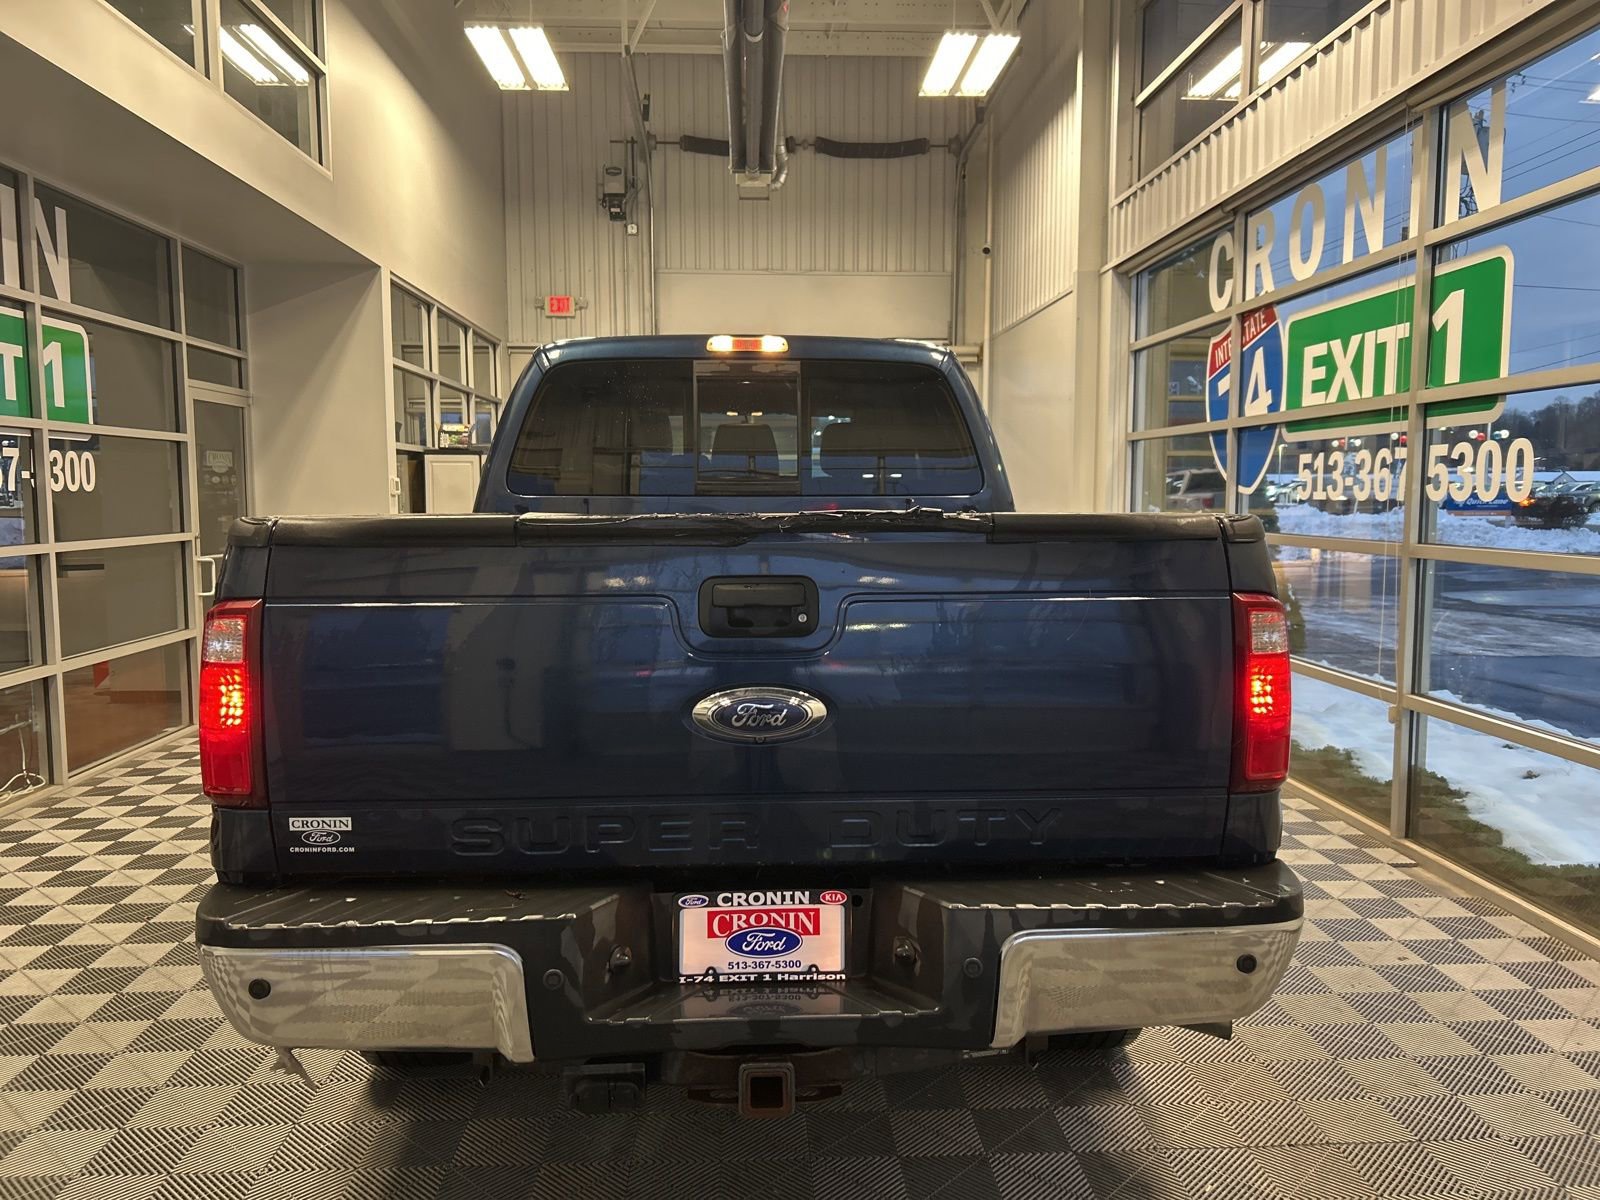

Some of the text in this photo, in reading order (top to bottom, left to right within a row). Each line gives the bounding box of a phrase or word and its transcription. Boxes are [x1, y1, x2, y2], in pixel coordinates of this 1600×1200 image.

[1208, 83, 1507, 312] CRONIN
[1215, 308, 1268, 368] INTETATE
[1302, 289, 1465, 407] EXIT 1
[43, 341, 65, 408] 1
[731, 703, 788, 727] Ford
[291, 819, 349, 829] CRONIN
[450, 808, 1061, 856] SUPER DUTY
[309, 832, 334, 842] Ford
[717, 891, 810, 906] CRONIN
[825, 893, 843, 901] KIA
[712, 911, 815, 936] CRONIN
[742, 932, 786, 951] Ford
[728, 960, 802, 970] 513-367-5300
[679, 975, 715, 984] I-74
[719, 974, 758, 982] EXIT
[777, 973, 846, 981] Harrison
